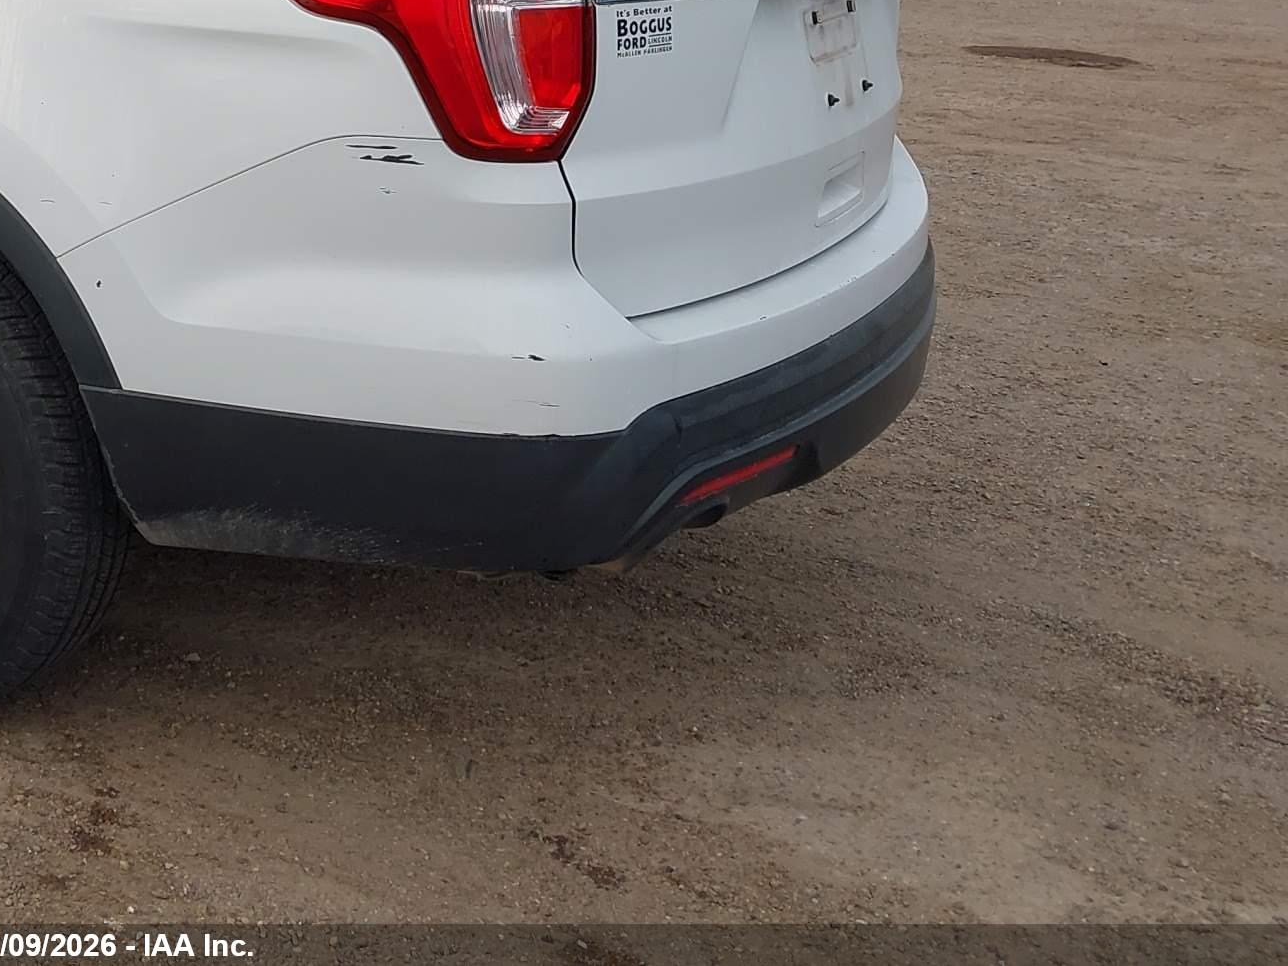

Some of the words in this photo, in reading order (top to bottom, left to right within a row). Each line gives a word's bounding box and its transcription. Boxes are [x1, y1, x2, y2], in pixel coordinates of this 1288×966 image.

[616, 9, 631, 18] It's
[633, 7, 661, 16] Better
[664, 5, 672, 13] at
[617, 16, 672, 37] BOGGUS
[617, 36, 647, 51] FORD
